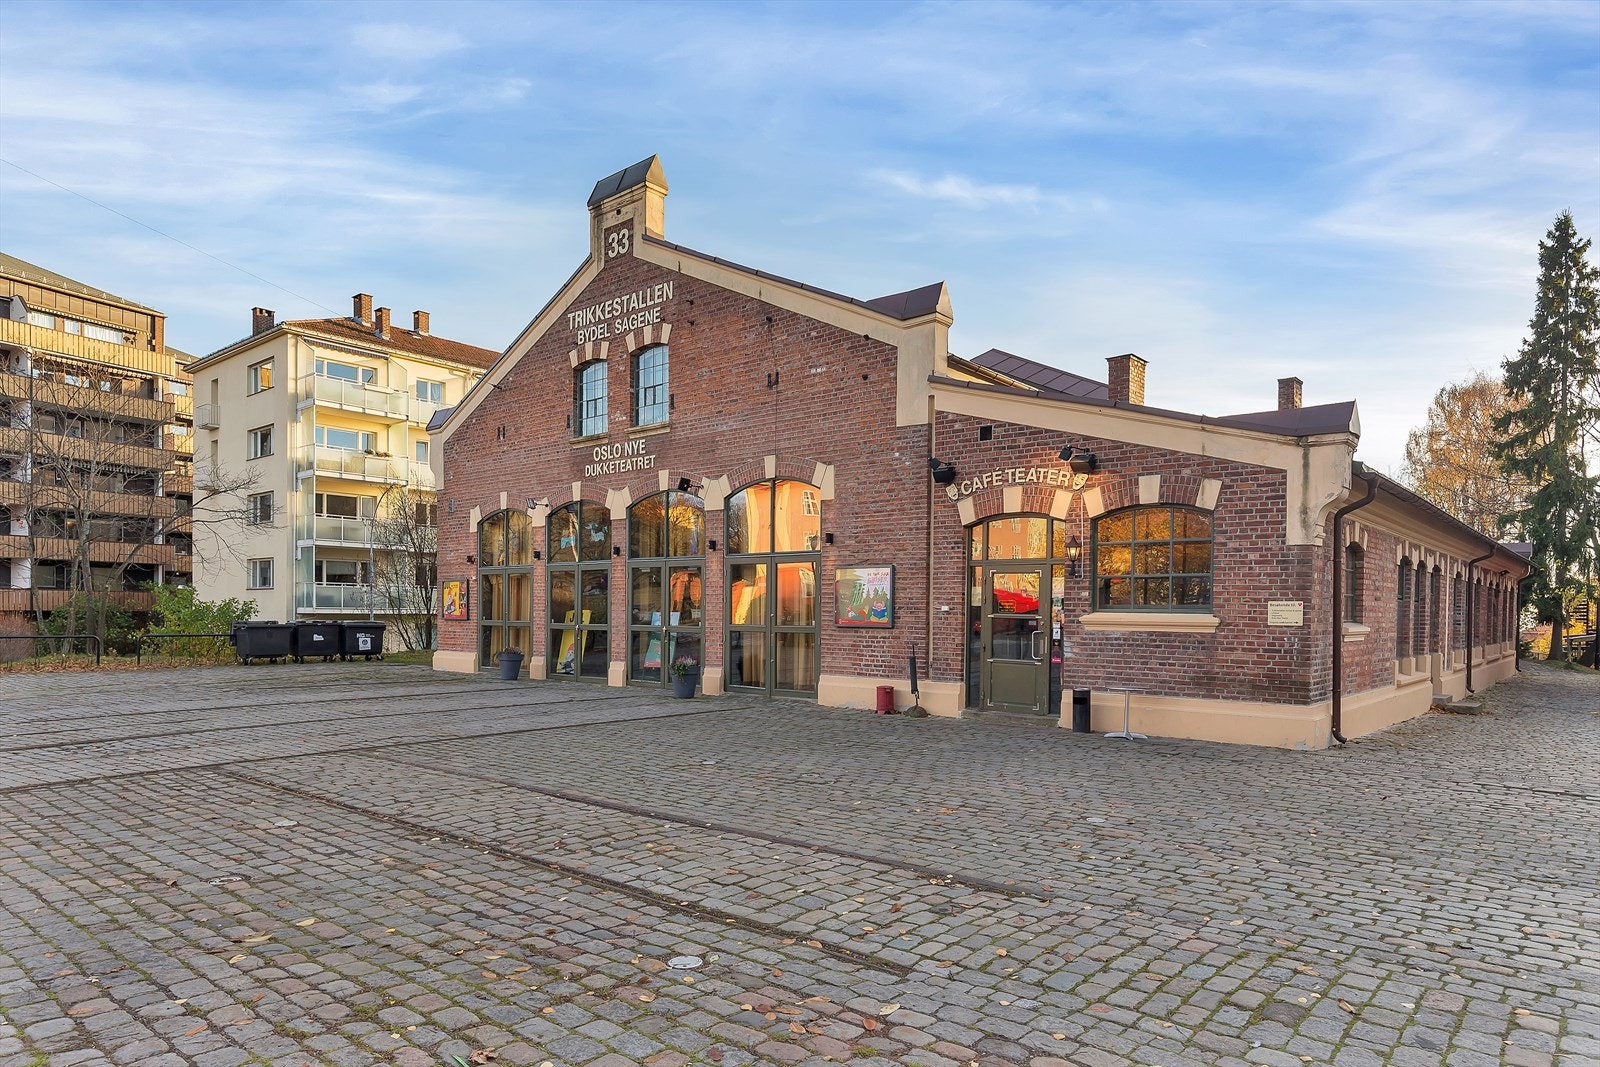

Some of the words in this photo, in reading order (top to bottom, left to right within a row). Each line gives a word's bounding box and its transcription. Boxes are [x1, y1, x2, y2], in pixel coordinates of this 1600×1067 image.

[608, 228, 629, 258] 33
[568, 281, 673, 330] TRIKKESTALLEN
[577, 323, 611, 345] BYDEL
[615, 307, 661, 334] SAGENE
[593, 443, 621, 461] OSLO
[624, 439, 646, 456] NYE
[585, 455, 656, 476] DUKKETEATRET
[960, 467, 1003, 496] CAFÉ
[1004, 467, 1071, 487] TEATER
